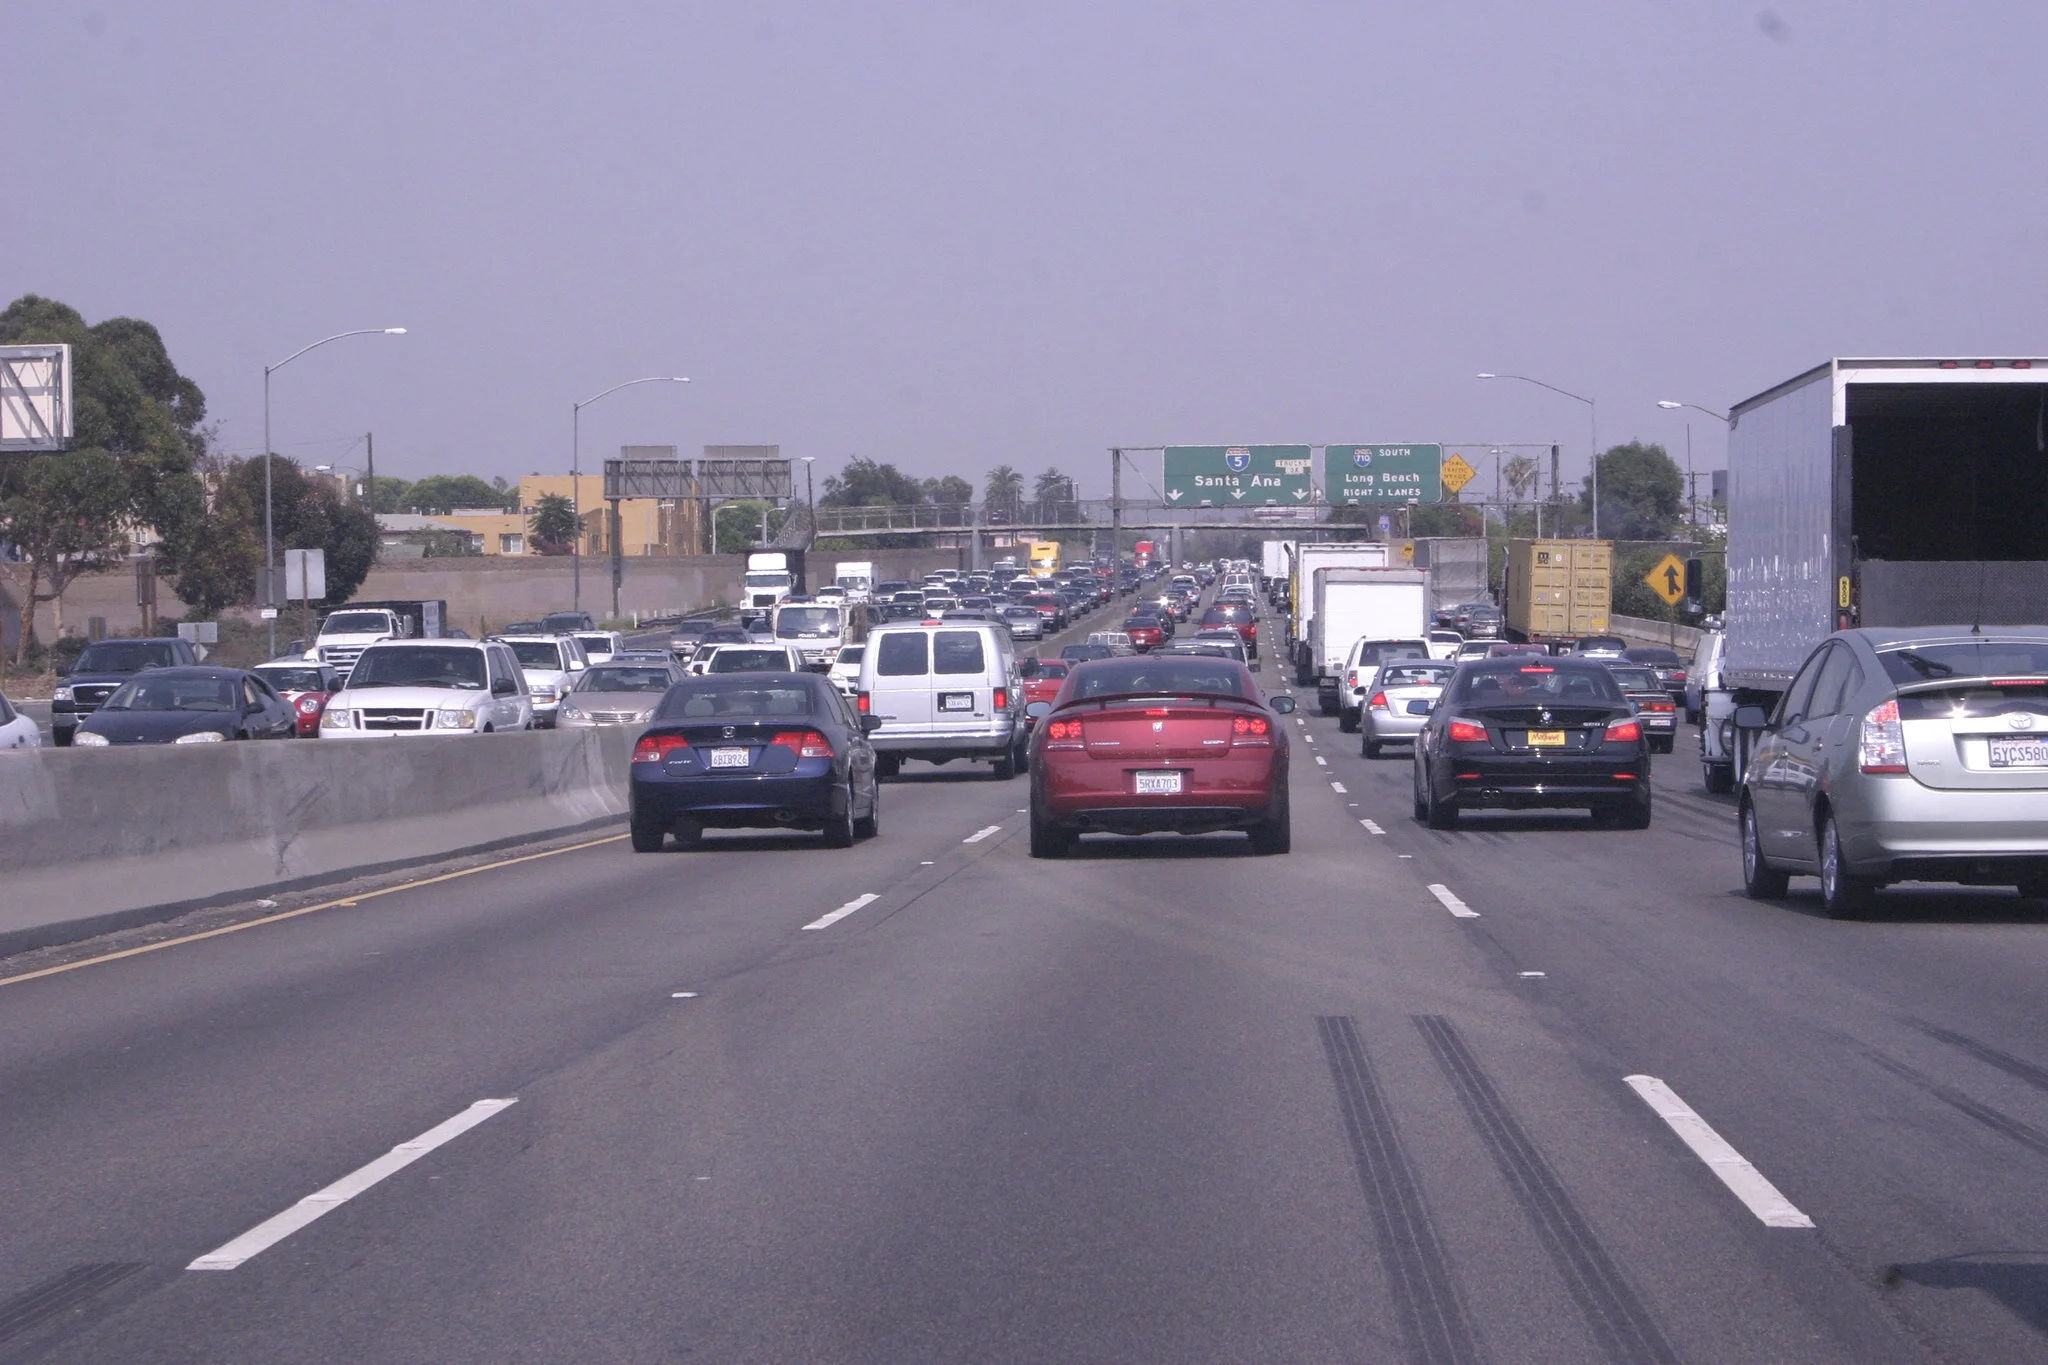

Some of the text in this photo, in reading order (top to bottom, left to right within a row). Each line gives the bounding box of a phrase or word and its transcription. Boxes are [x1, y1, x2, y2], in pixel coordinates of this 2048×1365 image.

[1379, 448, 1411, 457] SOUTH
[1234, 456, 1243, 467] 5
[1194, 475, 1281, 487] Santa Ana
[1345, 473, 1420, 486] Long Beach
[1343, 488, 1421, 497] RIGHT 3 LANES
[1992, 747, 2048, 762] 5YCS580
[1139, 778, 1178, 789] 5RXA703
